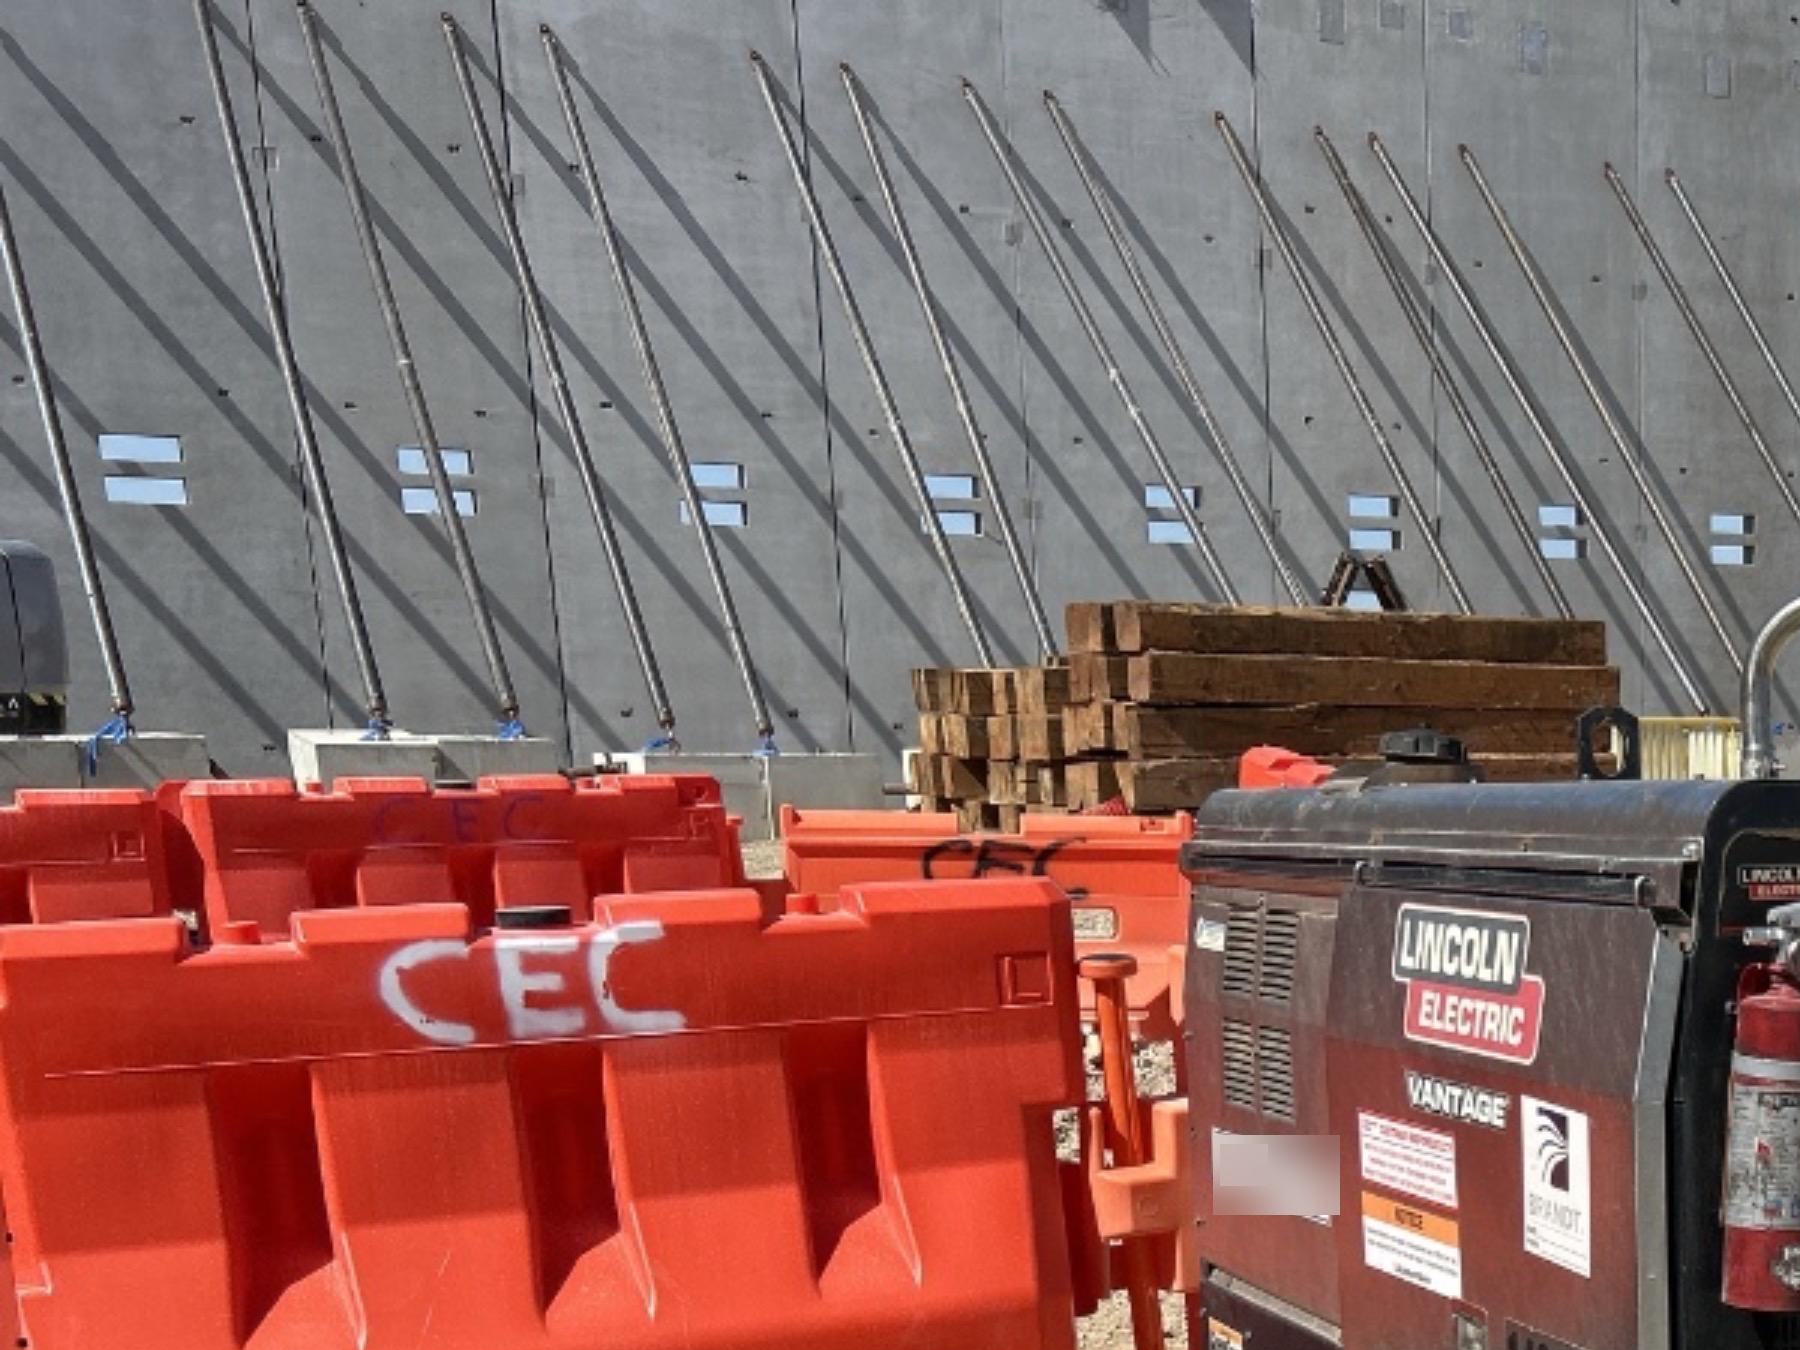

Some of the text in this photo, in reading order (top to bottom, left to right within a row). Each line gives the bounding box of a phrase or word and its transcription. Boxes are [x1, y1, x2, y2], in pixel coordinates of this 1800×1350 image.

[379, 920, 687, 1046] CEC
[1400, 919, 1520, 986] LINCOLN
[1418, 989, 1525, 1046] ELECTRIC
[1406, 1073, 1509, 1129] VANTAGE
